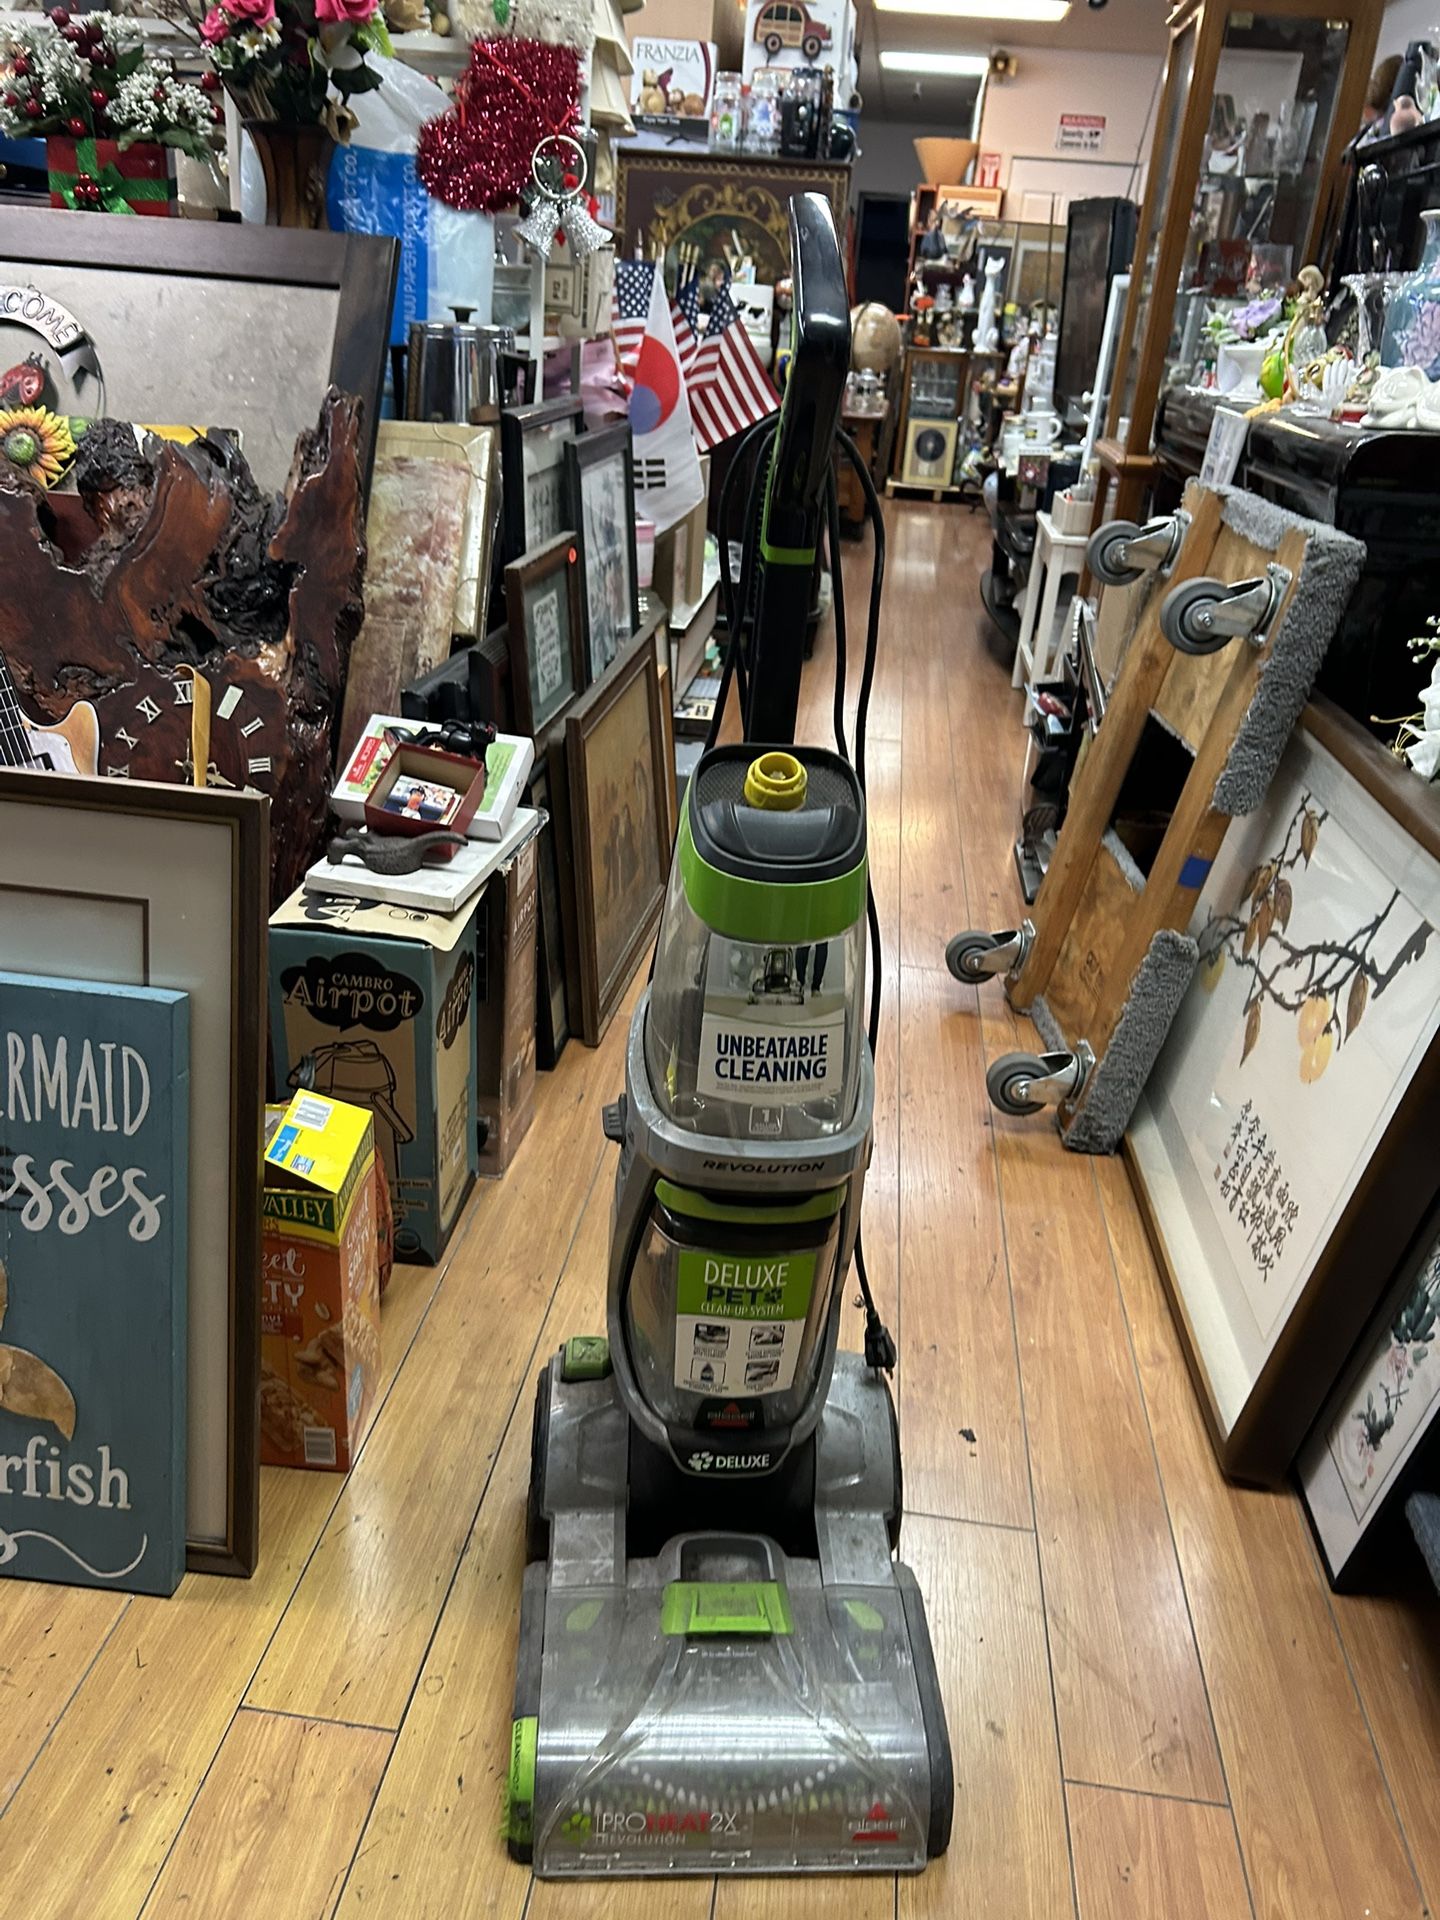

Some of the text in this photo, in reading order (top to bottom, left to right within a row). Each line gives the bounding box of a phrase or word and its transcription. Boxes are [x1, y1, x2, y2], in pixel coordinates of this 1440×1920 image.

[636, 43, 700, 64] FRANZIA
[331, 973, 393, 991] CAMBRO
[286, 976, 416, 1019] Airpot
[716, 1033, 828, 1058] UNBEATABLE
[715, 1058, 827, 1082] CLEANING
[0, 1031, 150, 1136] RMAID
[703, 1160, 825, 1172] REVOLUTION
[0, 1154, 166, 1242] sses
[704, 1260, 790, 1288] DELUXE
[706, 1286, 763, 1305] PET
[750, 1304, 784, 1316] SYSTEM
[715, 1454, 770, 1469] DELUXE
